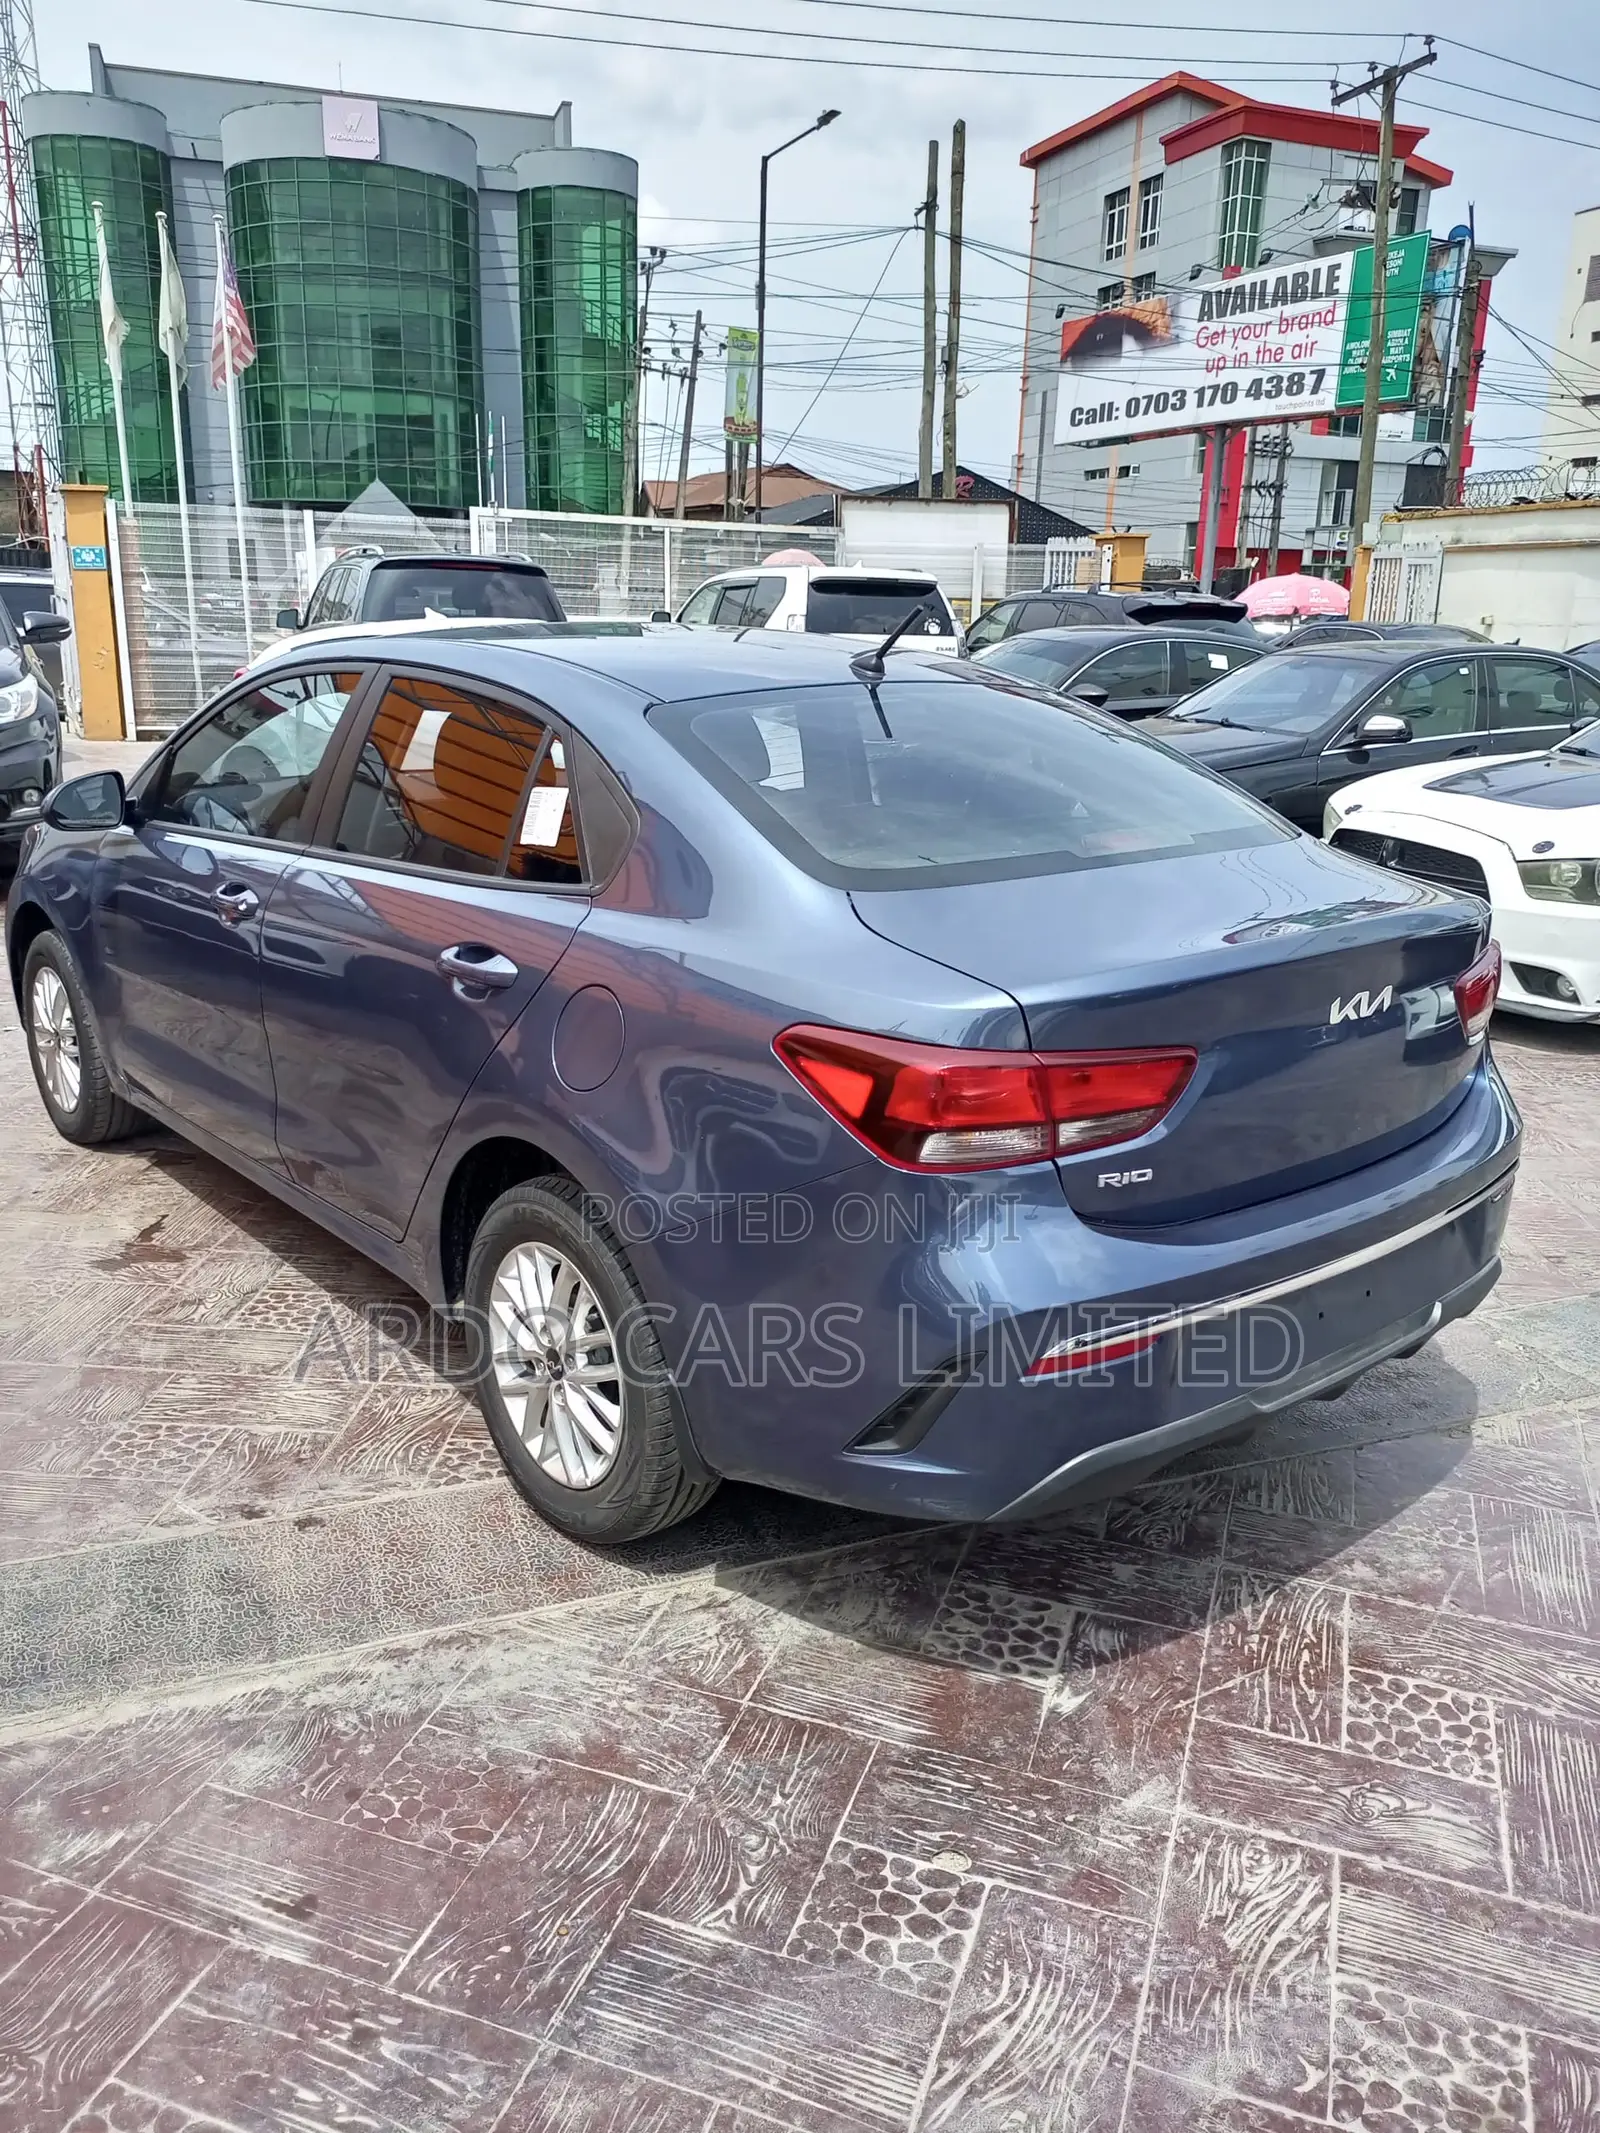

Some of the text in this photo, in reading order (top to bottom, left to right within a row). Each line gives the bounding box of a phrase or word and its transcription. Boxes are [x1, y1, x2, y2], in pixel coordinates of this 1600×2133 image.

[1197, 262, 1342, 323] AVAILABLE
[1196, 300, 1337, 349] Get your brand
[1205, 334, 1318, 378] up in the air
[1070, 368, 1327, 428] Call: 0703 170 4387
[1097, 1168, 1153, 1188] RIO
